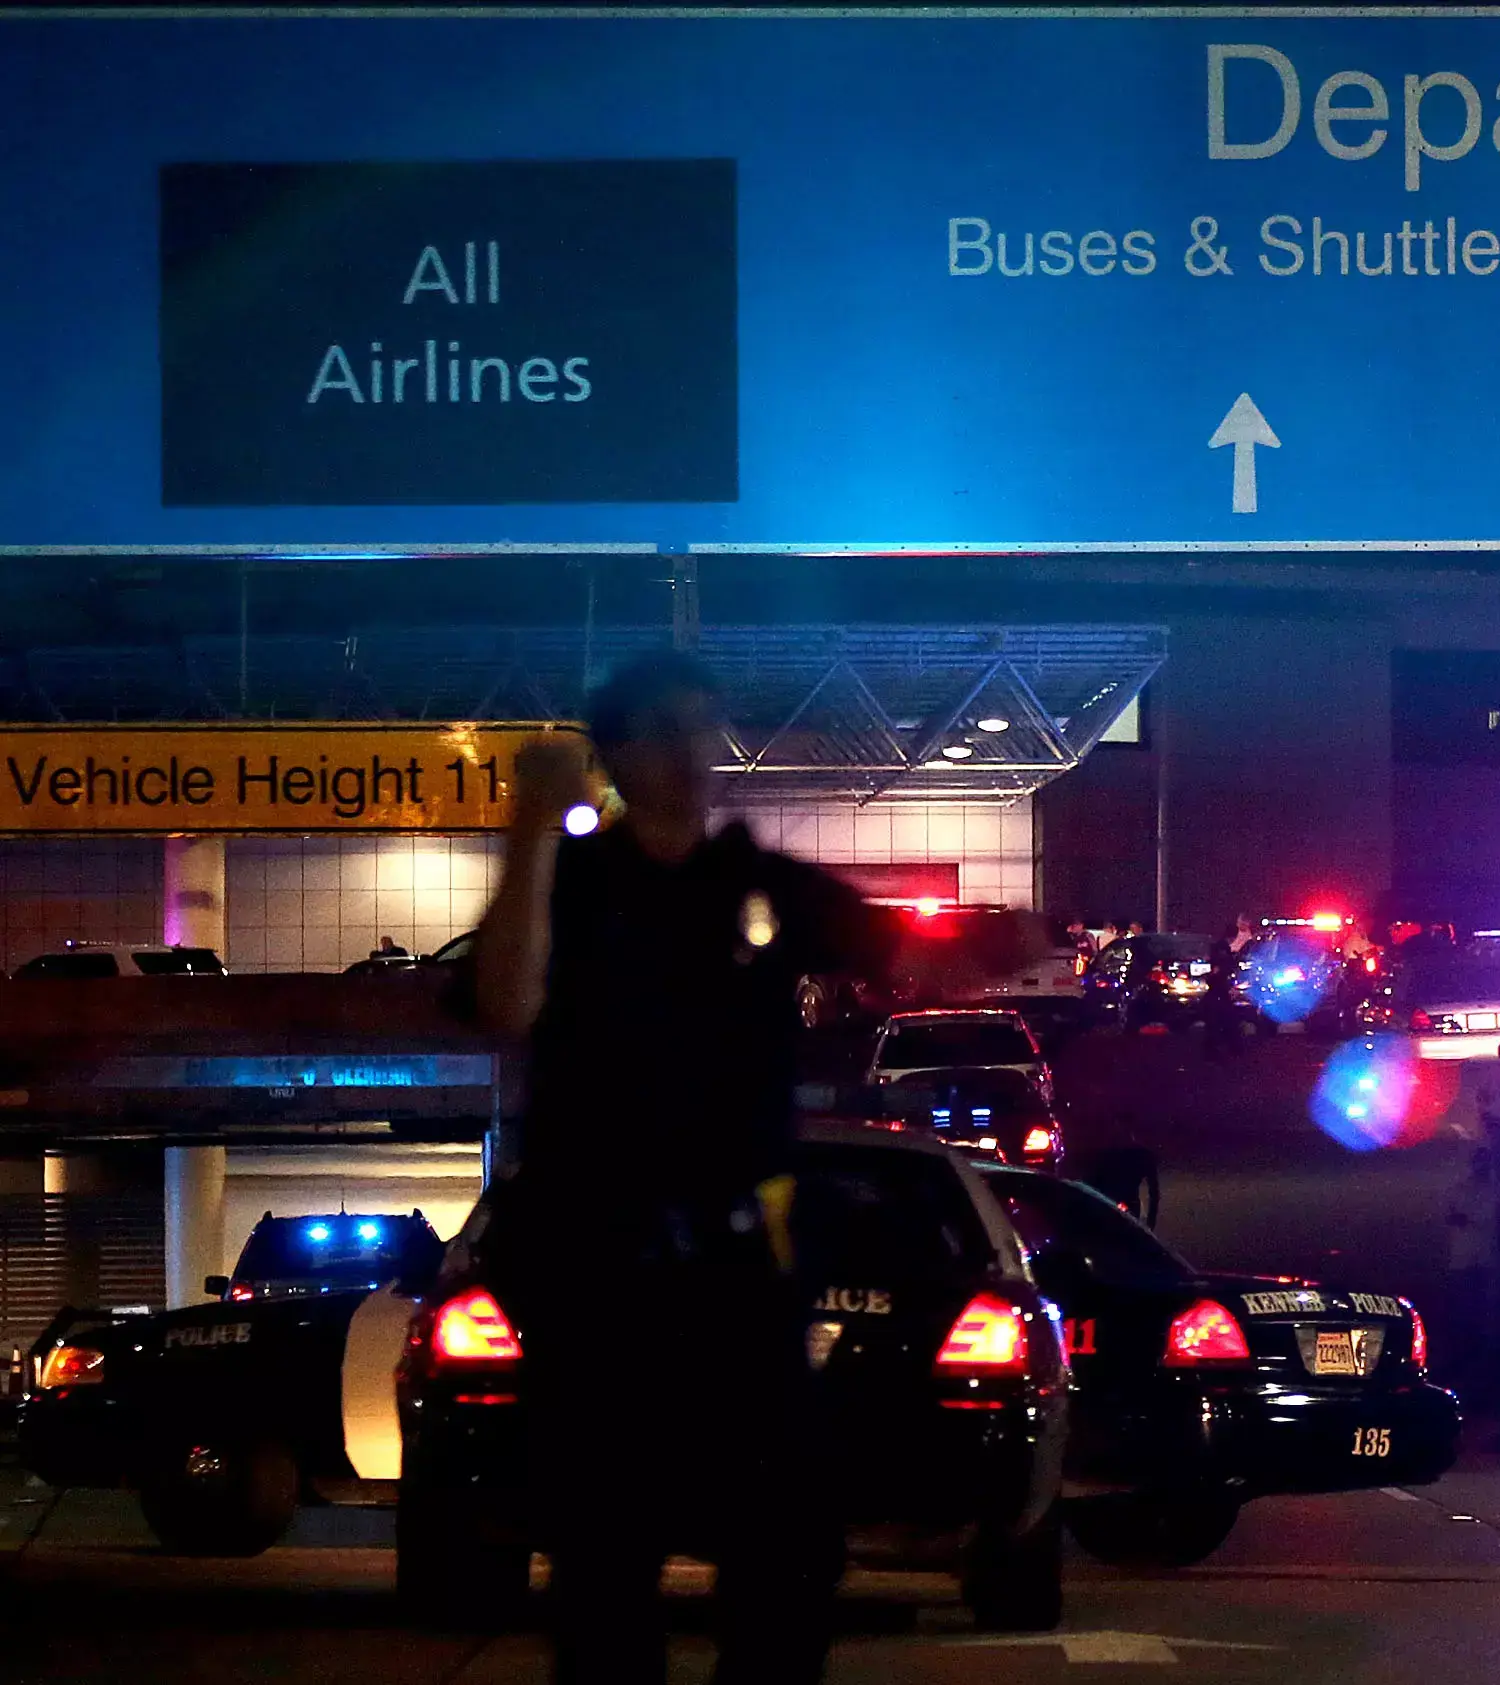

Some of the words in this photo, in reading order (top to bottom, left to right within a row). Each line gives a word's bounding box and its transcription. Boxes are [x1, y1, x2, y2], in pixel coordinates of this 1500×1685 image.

[403, 241, 500, 304] All
[948, 217, 1157, 276] Buses
[1184, 217, 1234, 276] &
[307, 340, 592, 403] Airlines
[7, 755, 214, 806] Vehicle
[237, 755, 424, 819] Height
[1240, 1290, 1326, 1315] KENNER
[1348, 1292, 1402, 1318] POLICE
[164, 1322, 252, 1349] POLICE
[1351, 1426, 1392, 1457] 135
